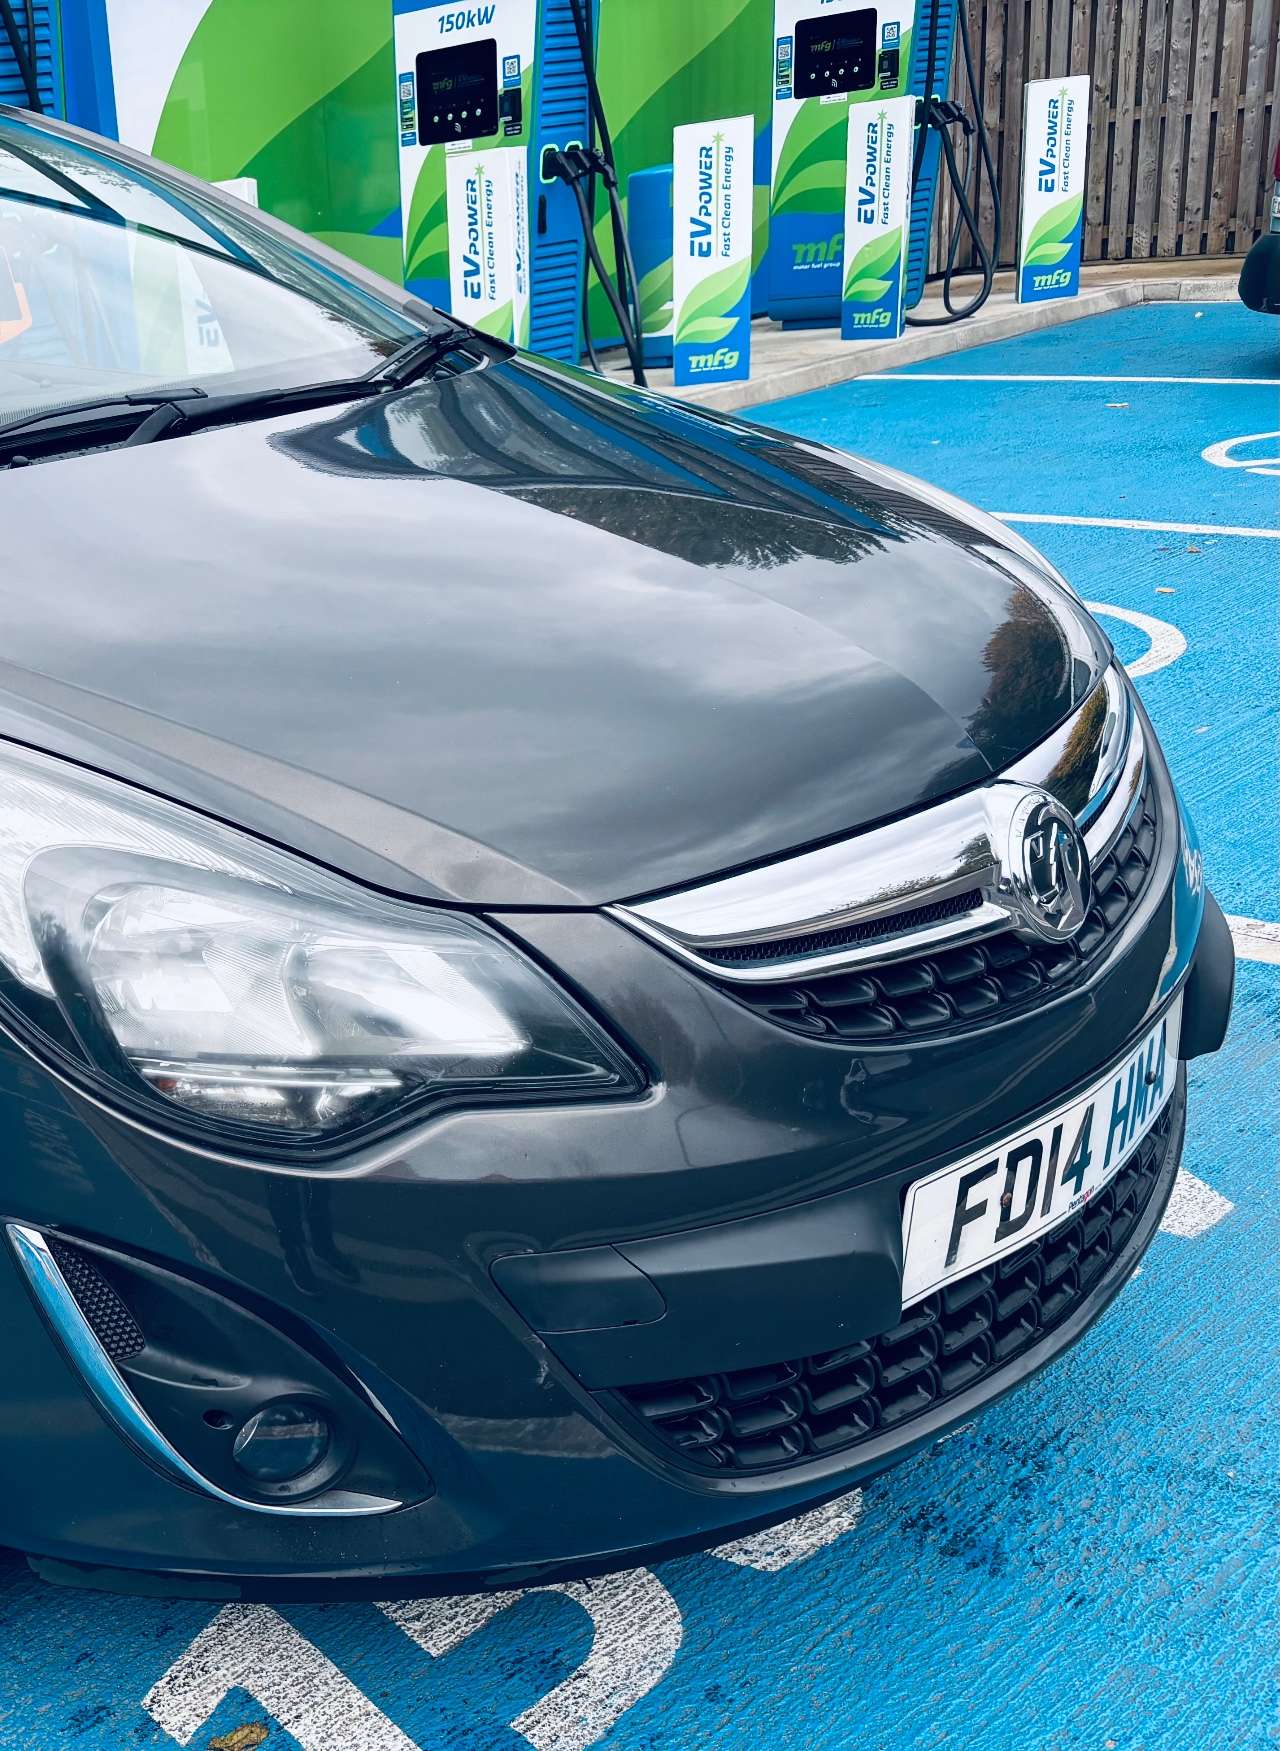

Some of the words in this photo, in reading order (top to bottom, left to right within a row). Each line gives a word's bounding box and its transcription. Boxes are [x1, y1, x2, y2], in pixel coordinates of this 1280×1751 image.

[438, 4, 496, 34] 150kW
[1065, 98, 1075, 136] Energy
[884, 123, 895, 166] Energy
[1062, 139, 1071, 169] Clean
[723, 146, 734, 190] Energy
[882, 167, 892, 199] Clean
[1061, 170, 1070, 193] Fast
[485, 179, 494, 228] Energy
[721, 195, 732, 229] Clean
[881, 201, 889, 226] Fast
[486, 232, 495, 270] Clean
[721, 229, 731, 257] Fast
[792, 232, 844, 264] mf
[488, 273, 496, 300] Fast
[1032, 268, 1072, 287] mfg
[852, 308, 892, 328] mfg
[688, 347, 740, 369] mfg
[944, 1101, 1096, 1269] FD14
[1103, 1017, 1167, 1170] HMA
